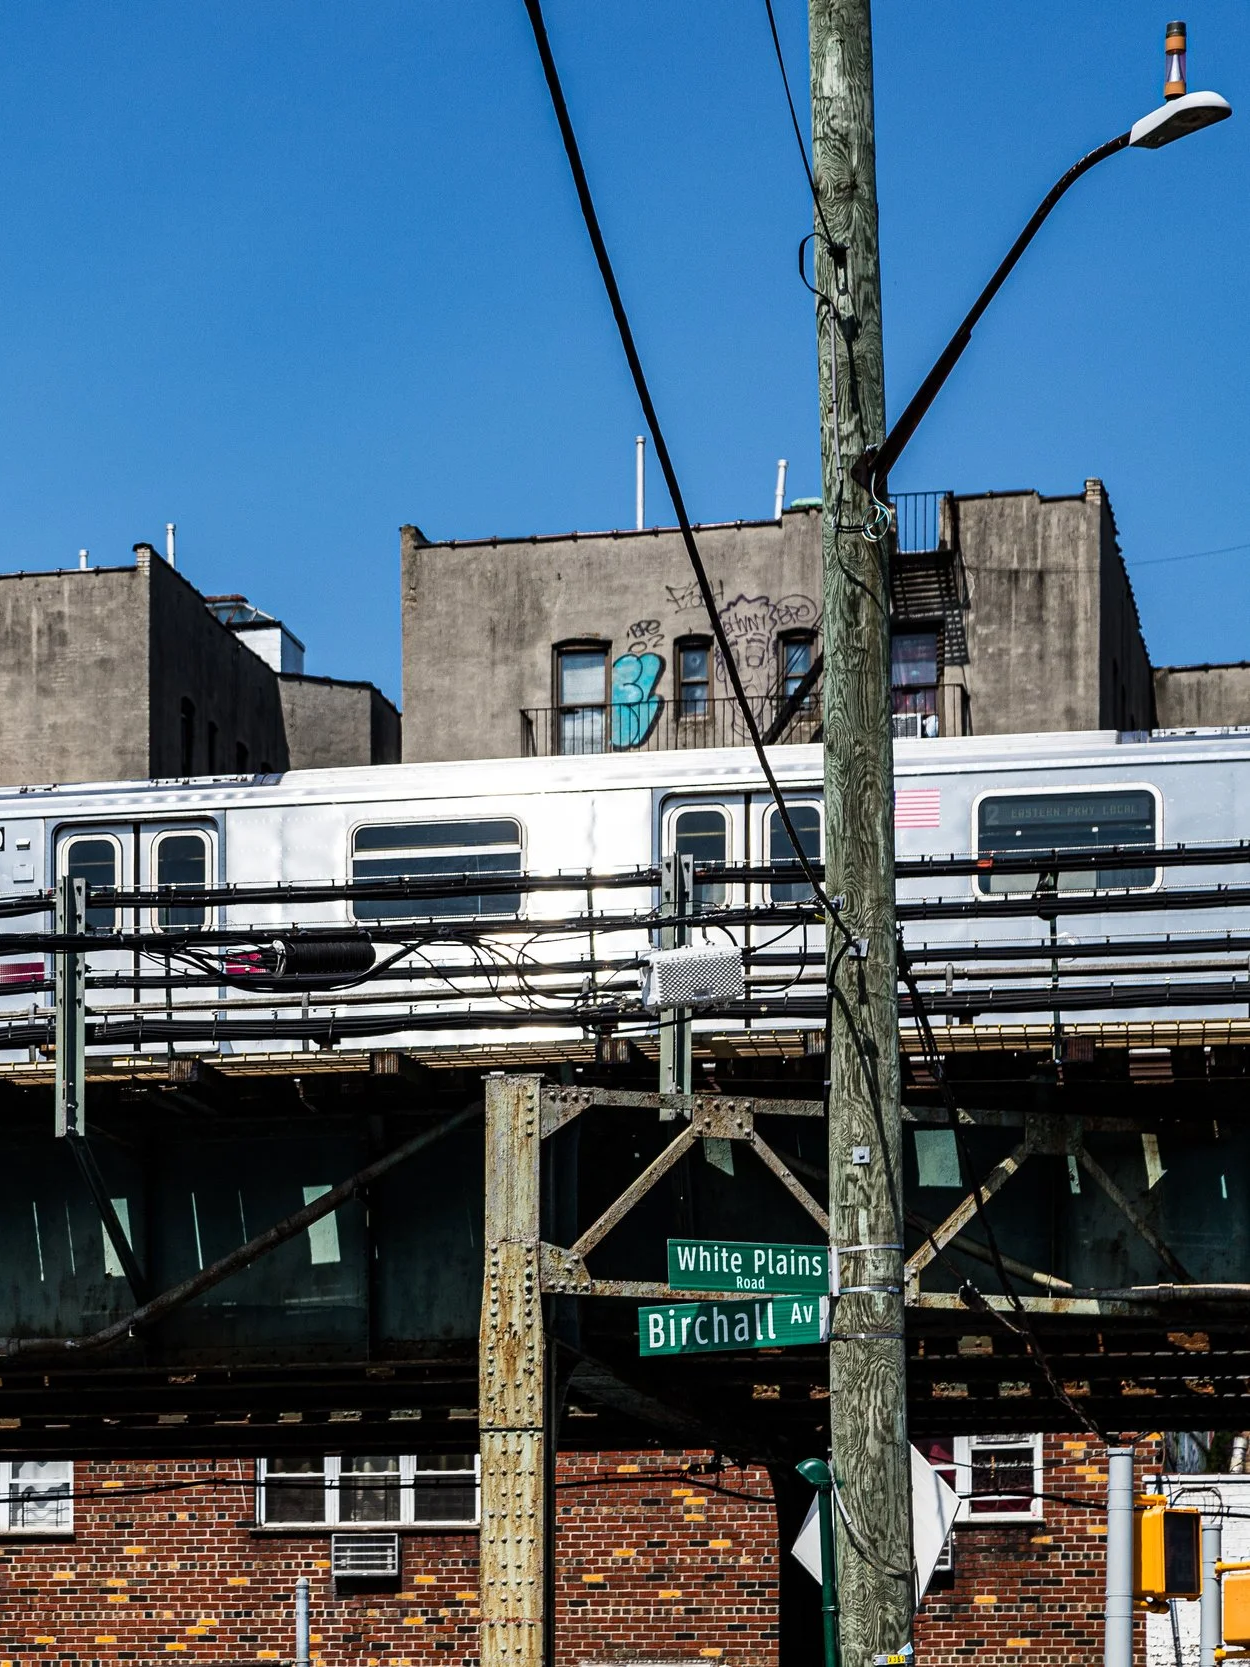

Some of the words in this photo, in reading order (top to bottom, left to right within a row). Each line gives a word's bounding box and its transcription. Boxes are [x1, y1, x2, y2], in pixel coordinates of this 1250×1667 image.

[986, 804, 999, 826] 2
[1011, 806, 1060, 819] EASTERN
[1067, 805, 1095, 817] PKWY
[1102, 803, 1138, 816] LOCAL
[677, 1245, 743, 1274] White
[754, 1248, 822, 1277] Plains
[736, 1276, 765, 1290] Road
[648, 1302, 777, 1349] Birchall
[790, 1302, 814, 1325] Av
